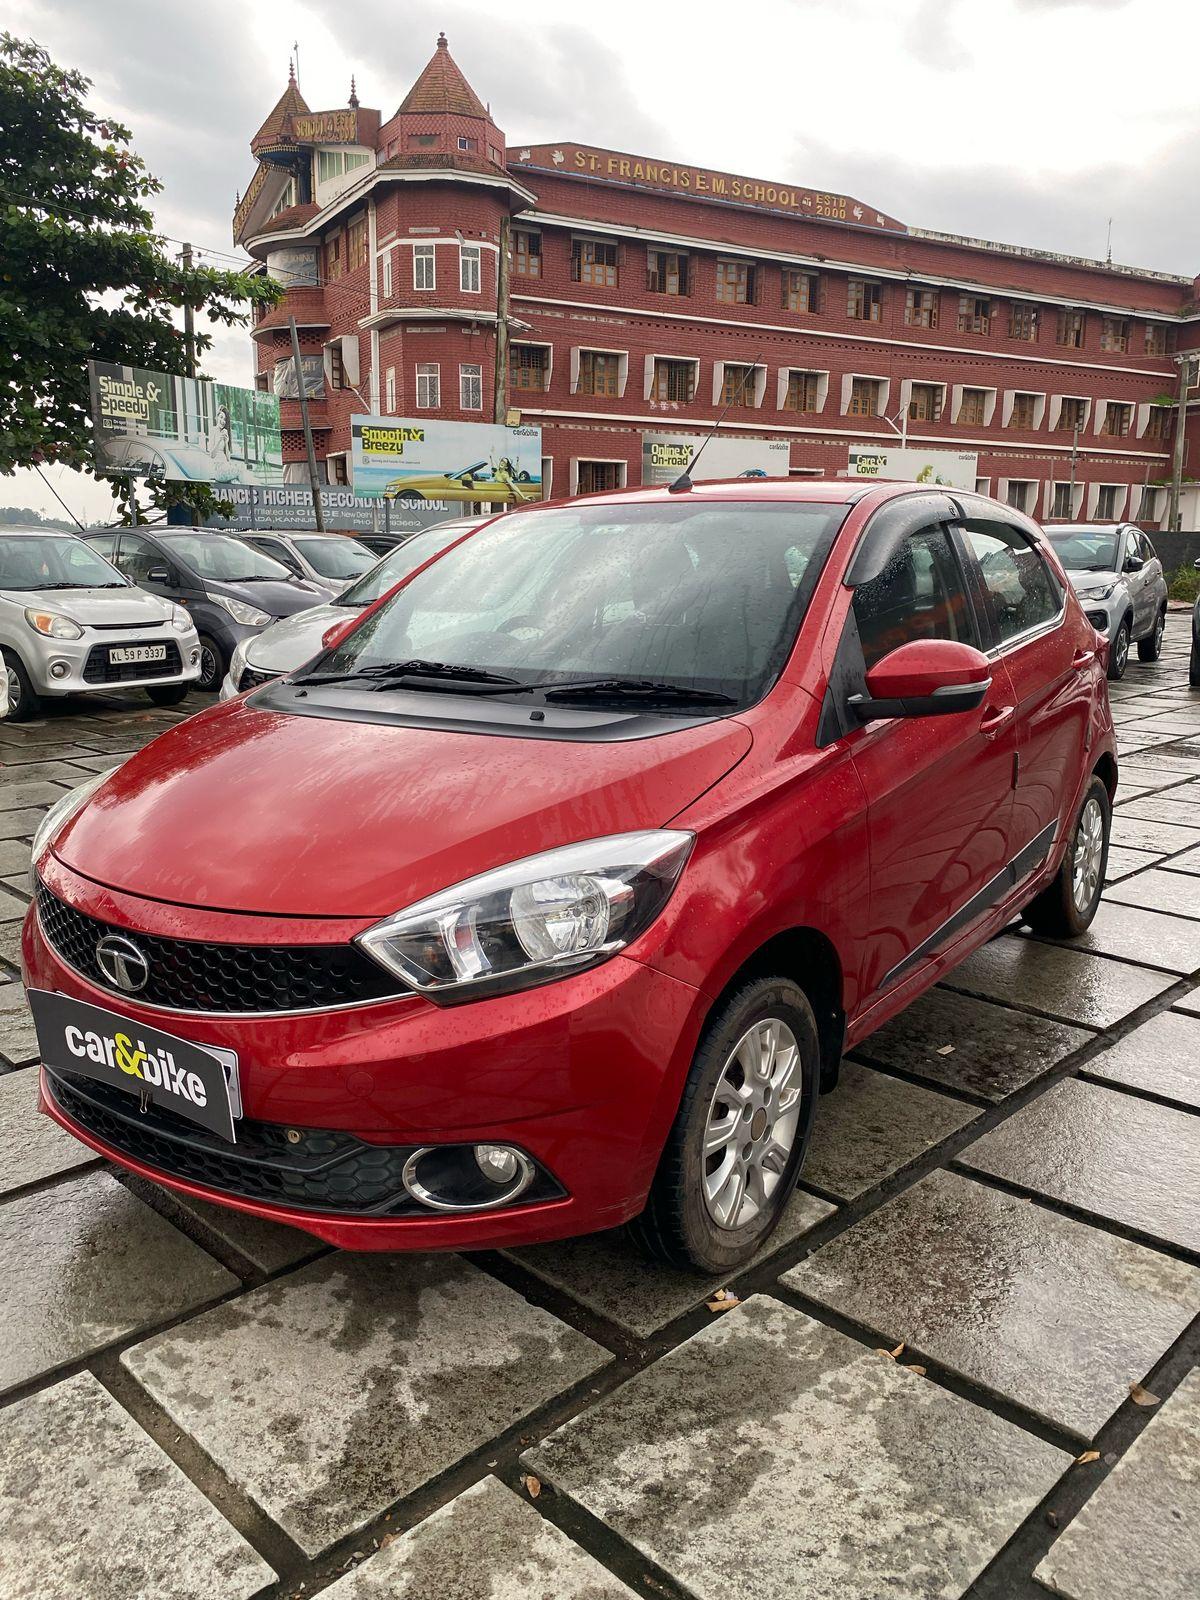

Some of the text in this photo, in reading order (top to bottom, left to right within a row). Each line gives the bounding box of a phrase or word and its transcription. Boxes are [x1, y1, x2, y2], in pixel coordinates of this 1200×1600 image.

[575, 151, 601, 171] ST.
[607, 158, 690, 188] FRANCIS
[732, 180, 799, 207] SCHOOL
[815, 194, 847, 208] ESTD
[815, 205, 847, 219] 2000
[99, 375, 161, 402] Simple &
[100, 394, 148, 418] Speedy
[361, 426, 409, 442] Smooth
[362, 438, 404, 455] Breezy
[652, 444, 681, 456] Online
[651, 454, 688, 466] On-road
[857, 455, 876, 466] Care
[857, 464, 878, 474] Cover
[210, 488, 258, 505] RANCIS
[263, 490, 314, 506] HIGHER
[111, 648, 164, 662] KL 59 P 9337
[65, 1025, 207, 1107] car&bike
